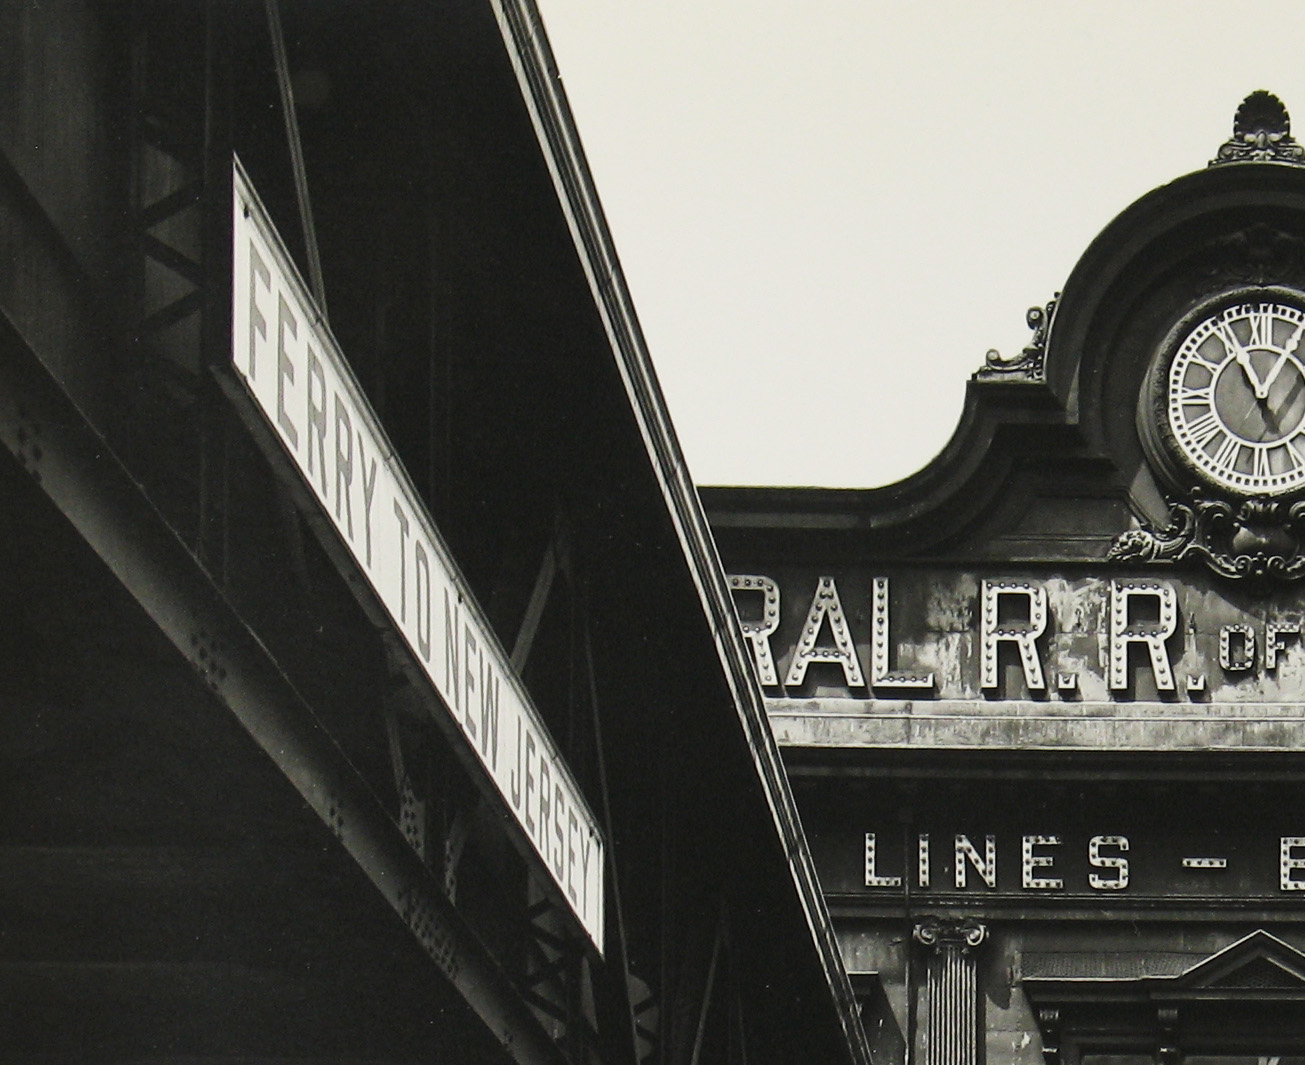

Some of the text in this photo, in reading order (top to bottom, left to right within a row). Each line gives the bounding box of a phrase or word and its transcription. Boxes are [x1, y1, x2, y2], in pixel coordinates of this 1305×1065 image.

[249, 237, 591, 922] FERRY TO NEW JERSEY
[1219, 623, 1301, 671] OF
[865, 833, 1130, 890] LINES
